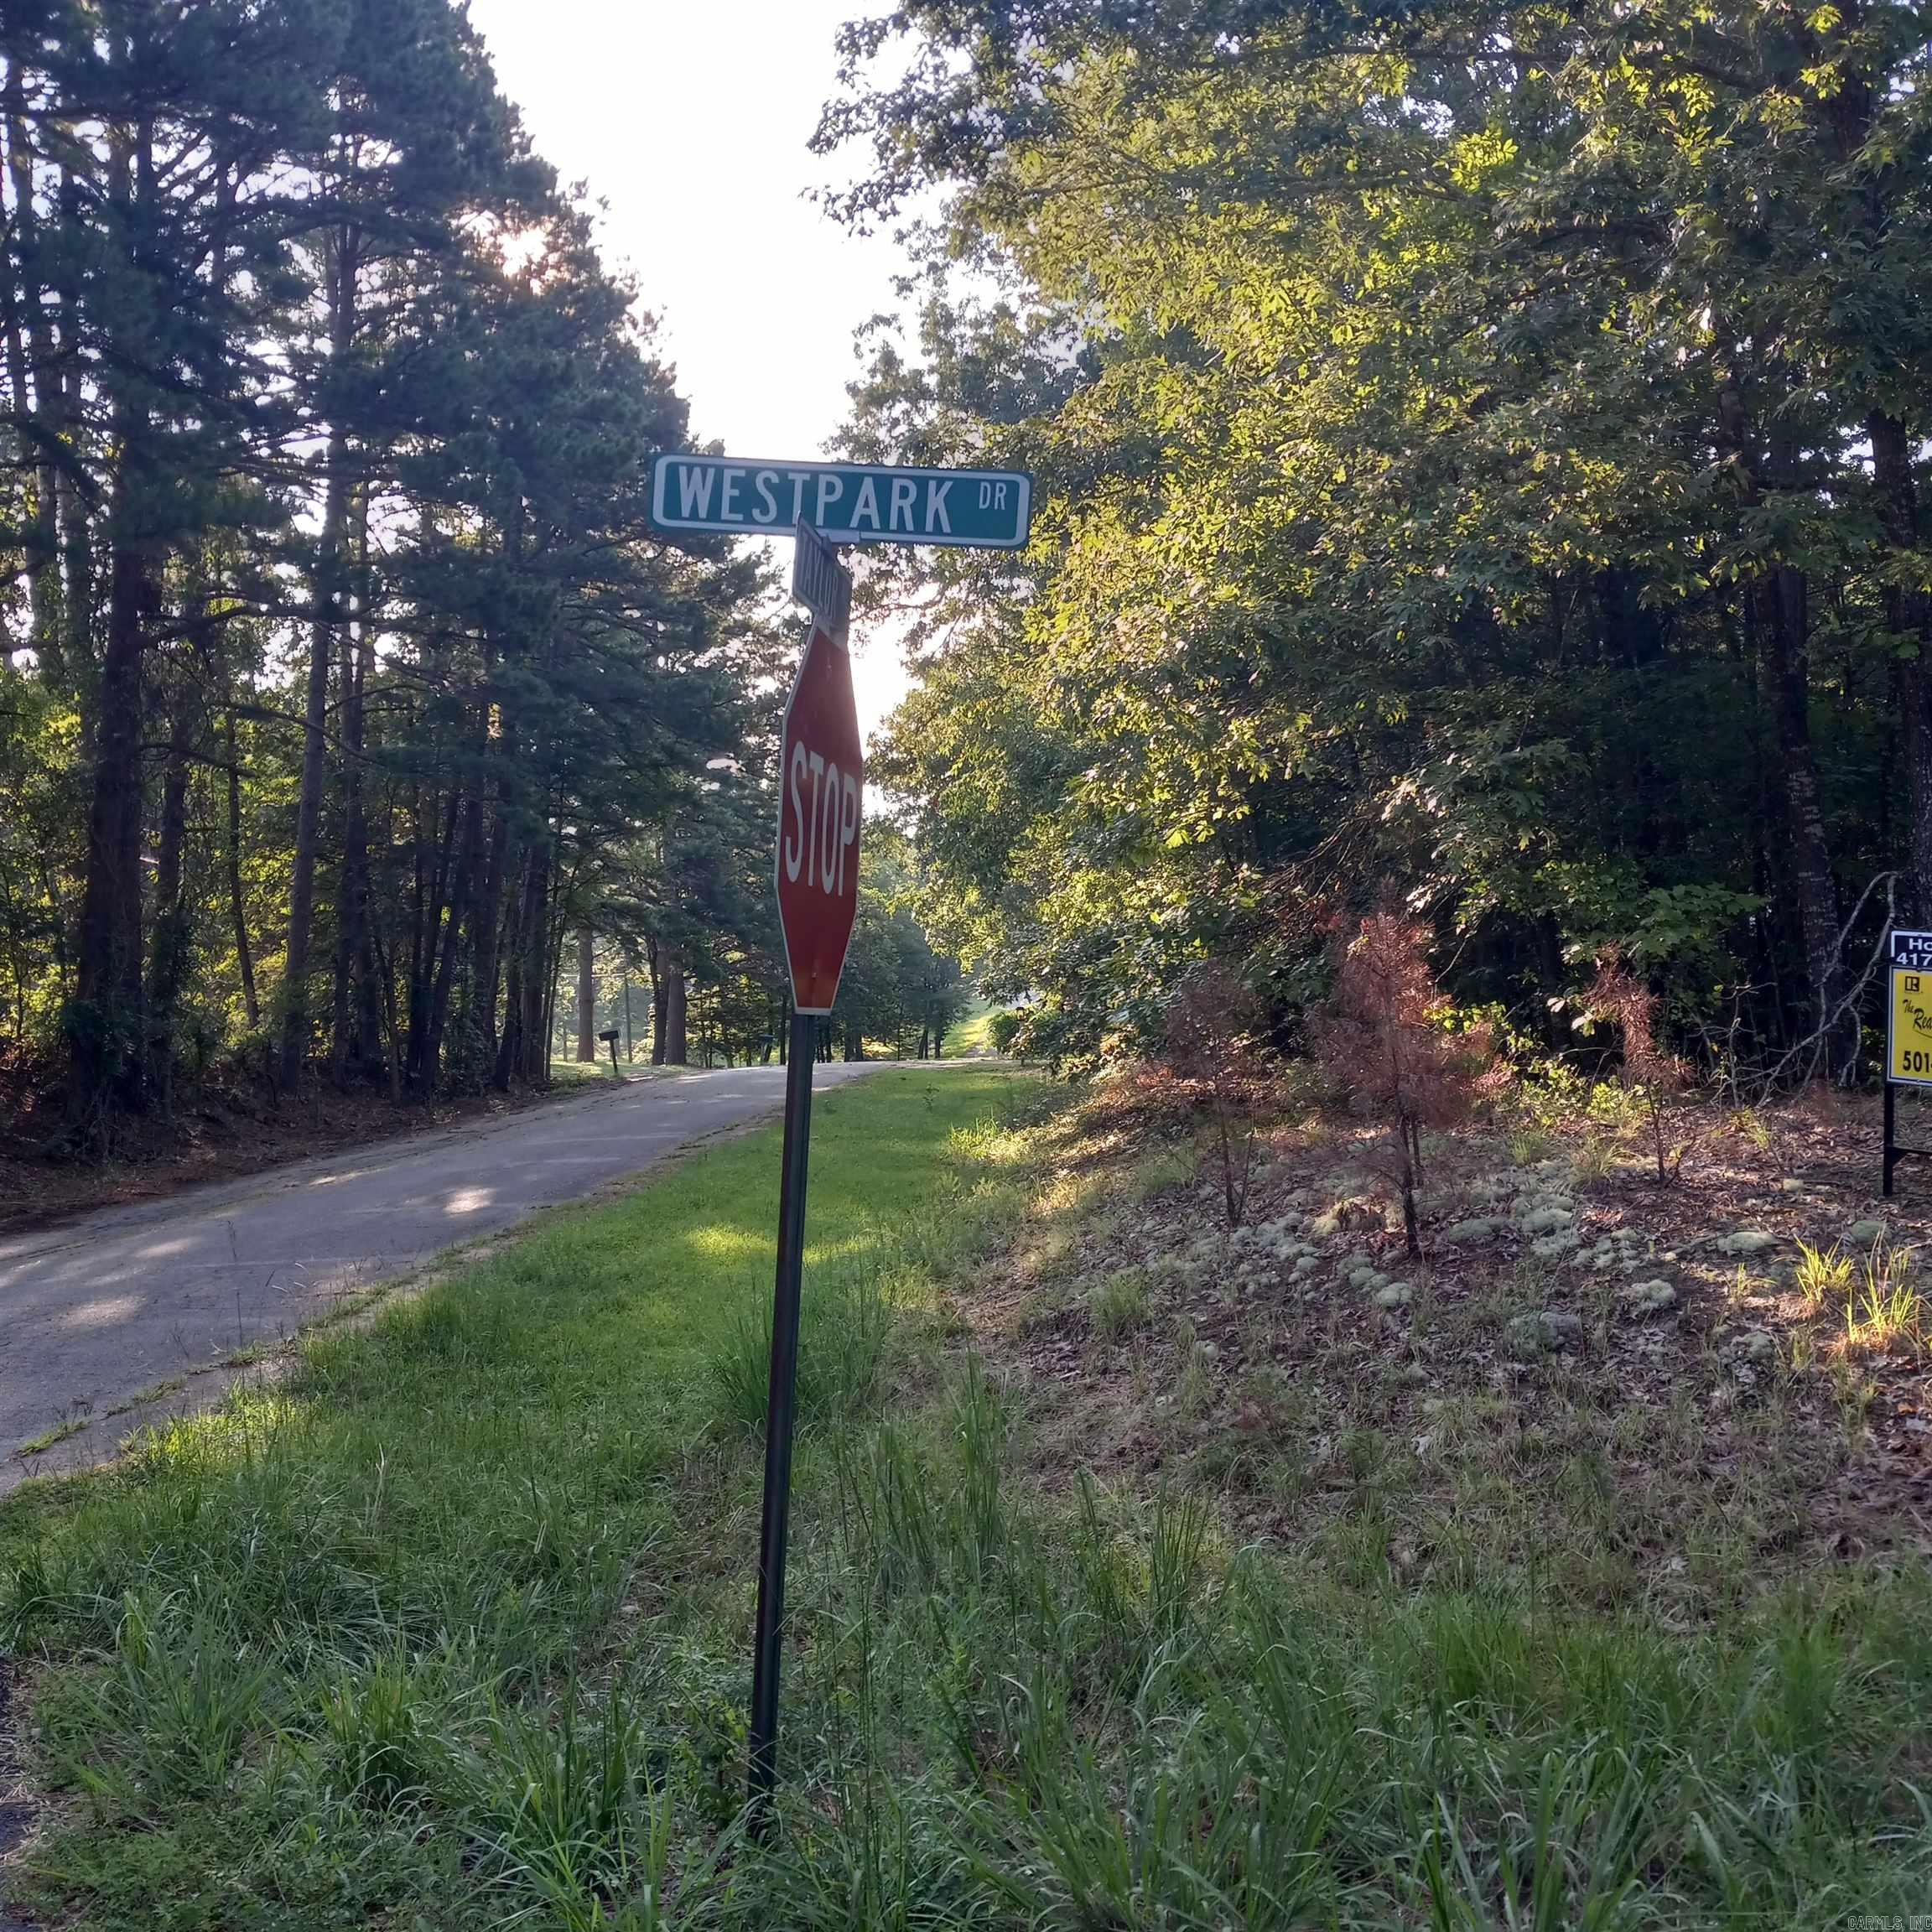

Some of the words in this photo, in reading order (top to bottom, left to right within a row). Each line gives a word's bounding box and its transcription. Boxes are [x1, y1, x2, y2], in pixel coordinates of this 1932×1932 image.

[678, 465, 953, 534] WESTPARK
[979, 480, 1007, 511] DR
[785, 740, 858, 896] STOP
